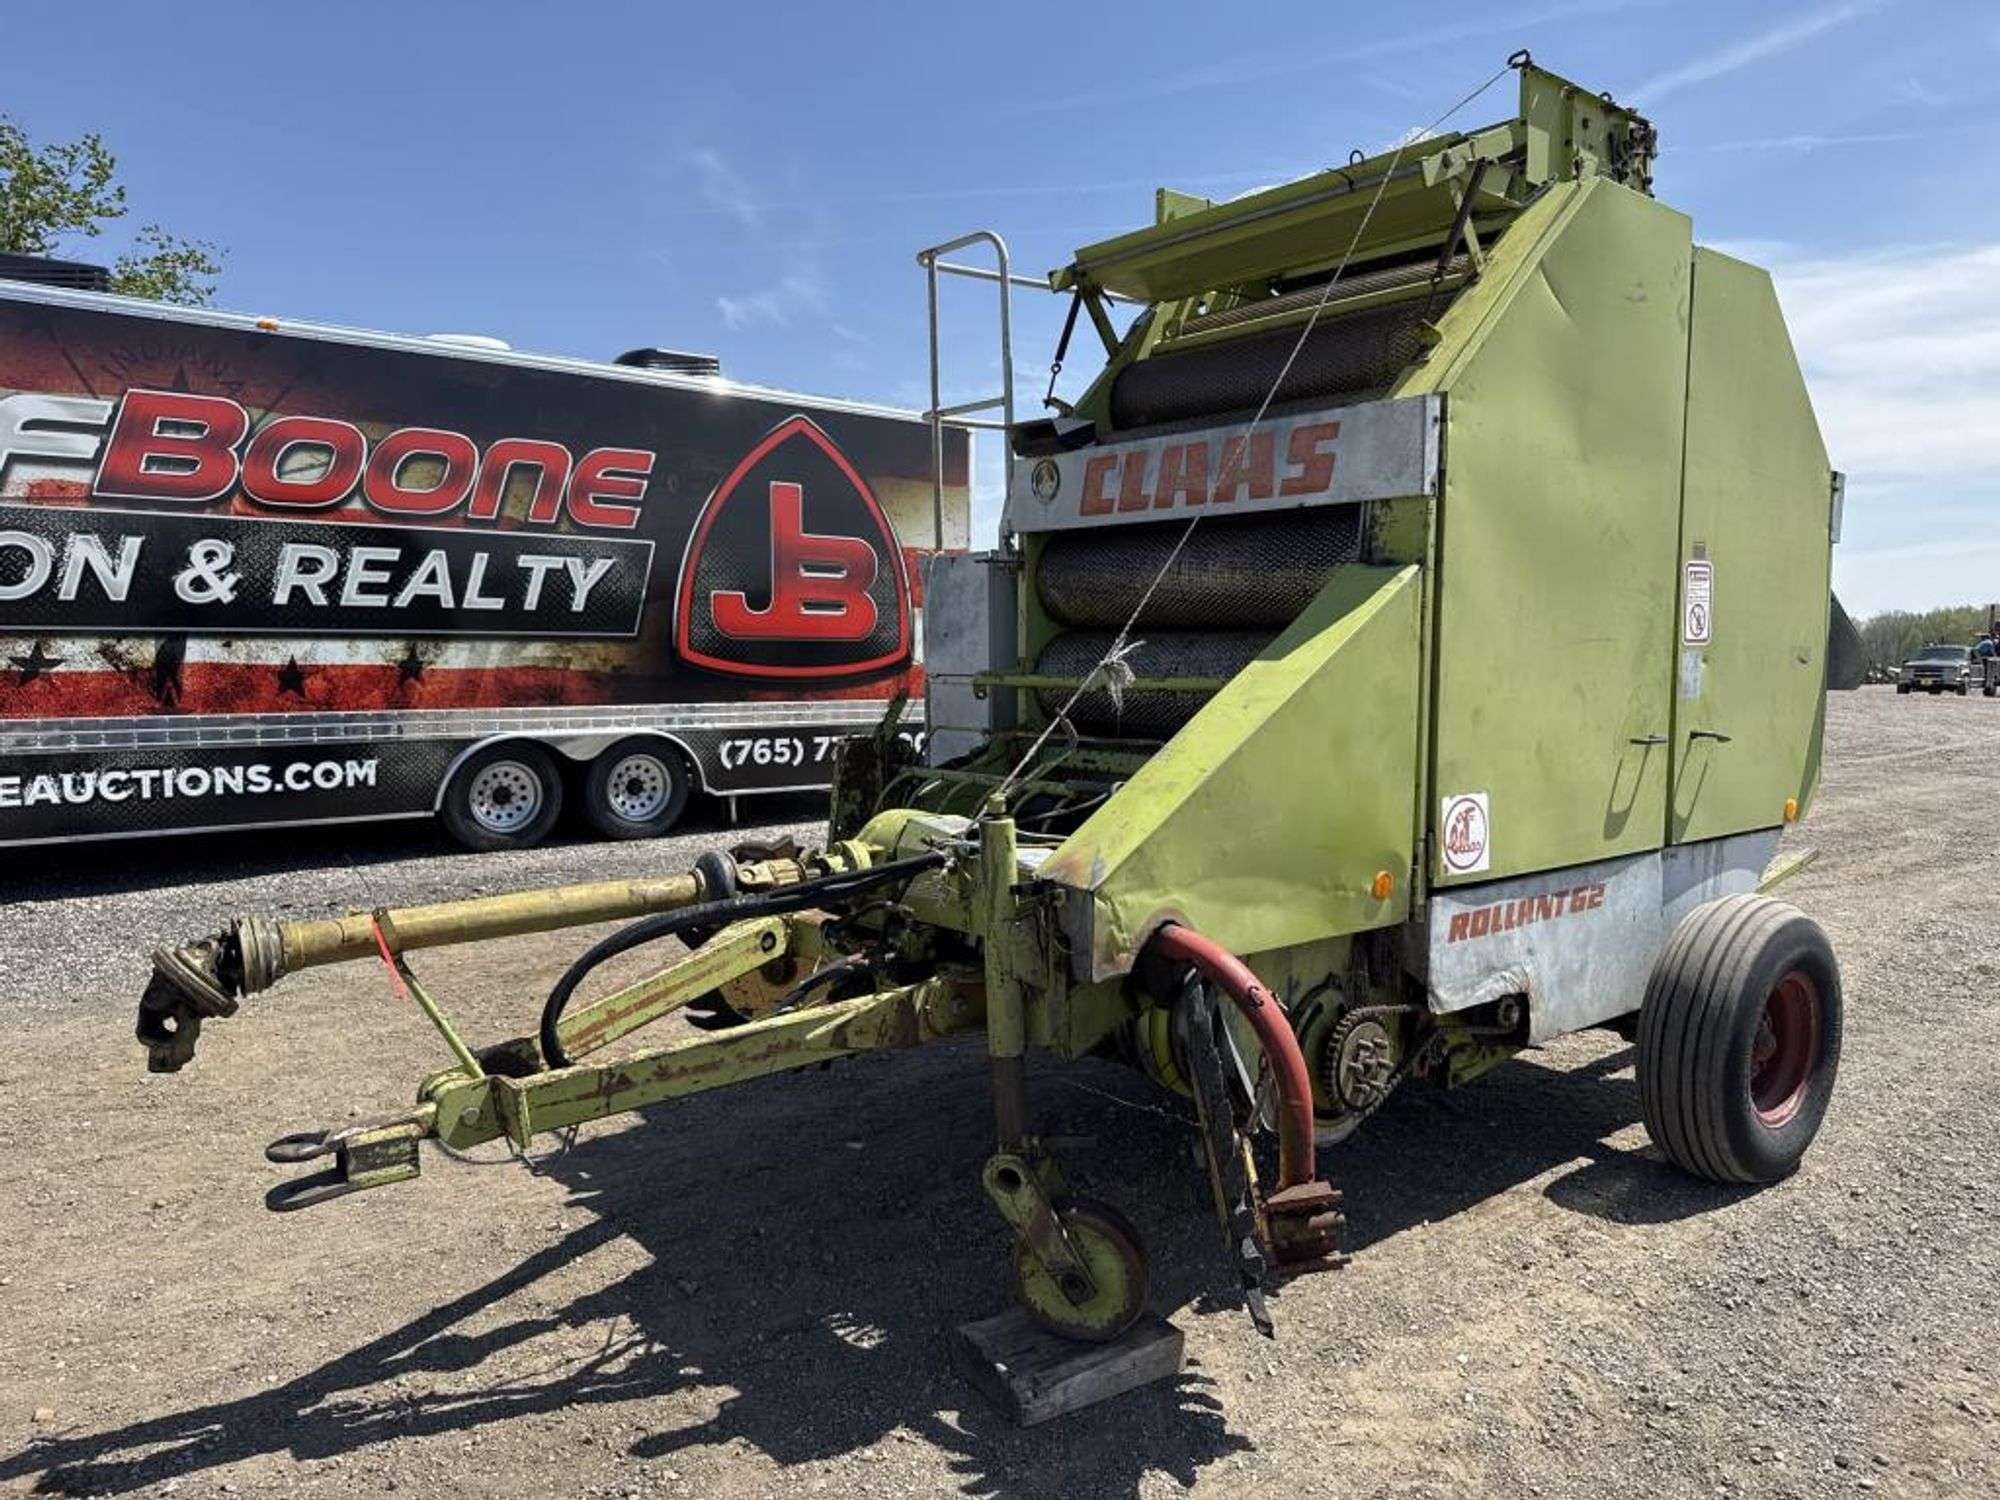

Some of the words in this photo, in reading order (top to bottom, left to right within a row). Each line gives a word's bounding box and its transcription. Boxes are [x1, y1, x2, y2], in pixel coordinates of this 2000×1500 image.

[1080, 421, 1340, 517] CLAAS
[174, 539, 242, 604] &
[272, 543, 617, 611] REALTY
[711, 481, 878, 640] JB
[0, 759, 378, 807] EAUCTIONS.COM
[720, 736, 804, 770] (765)
